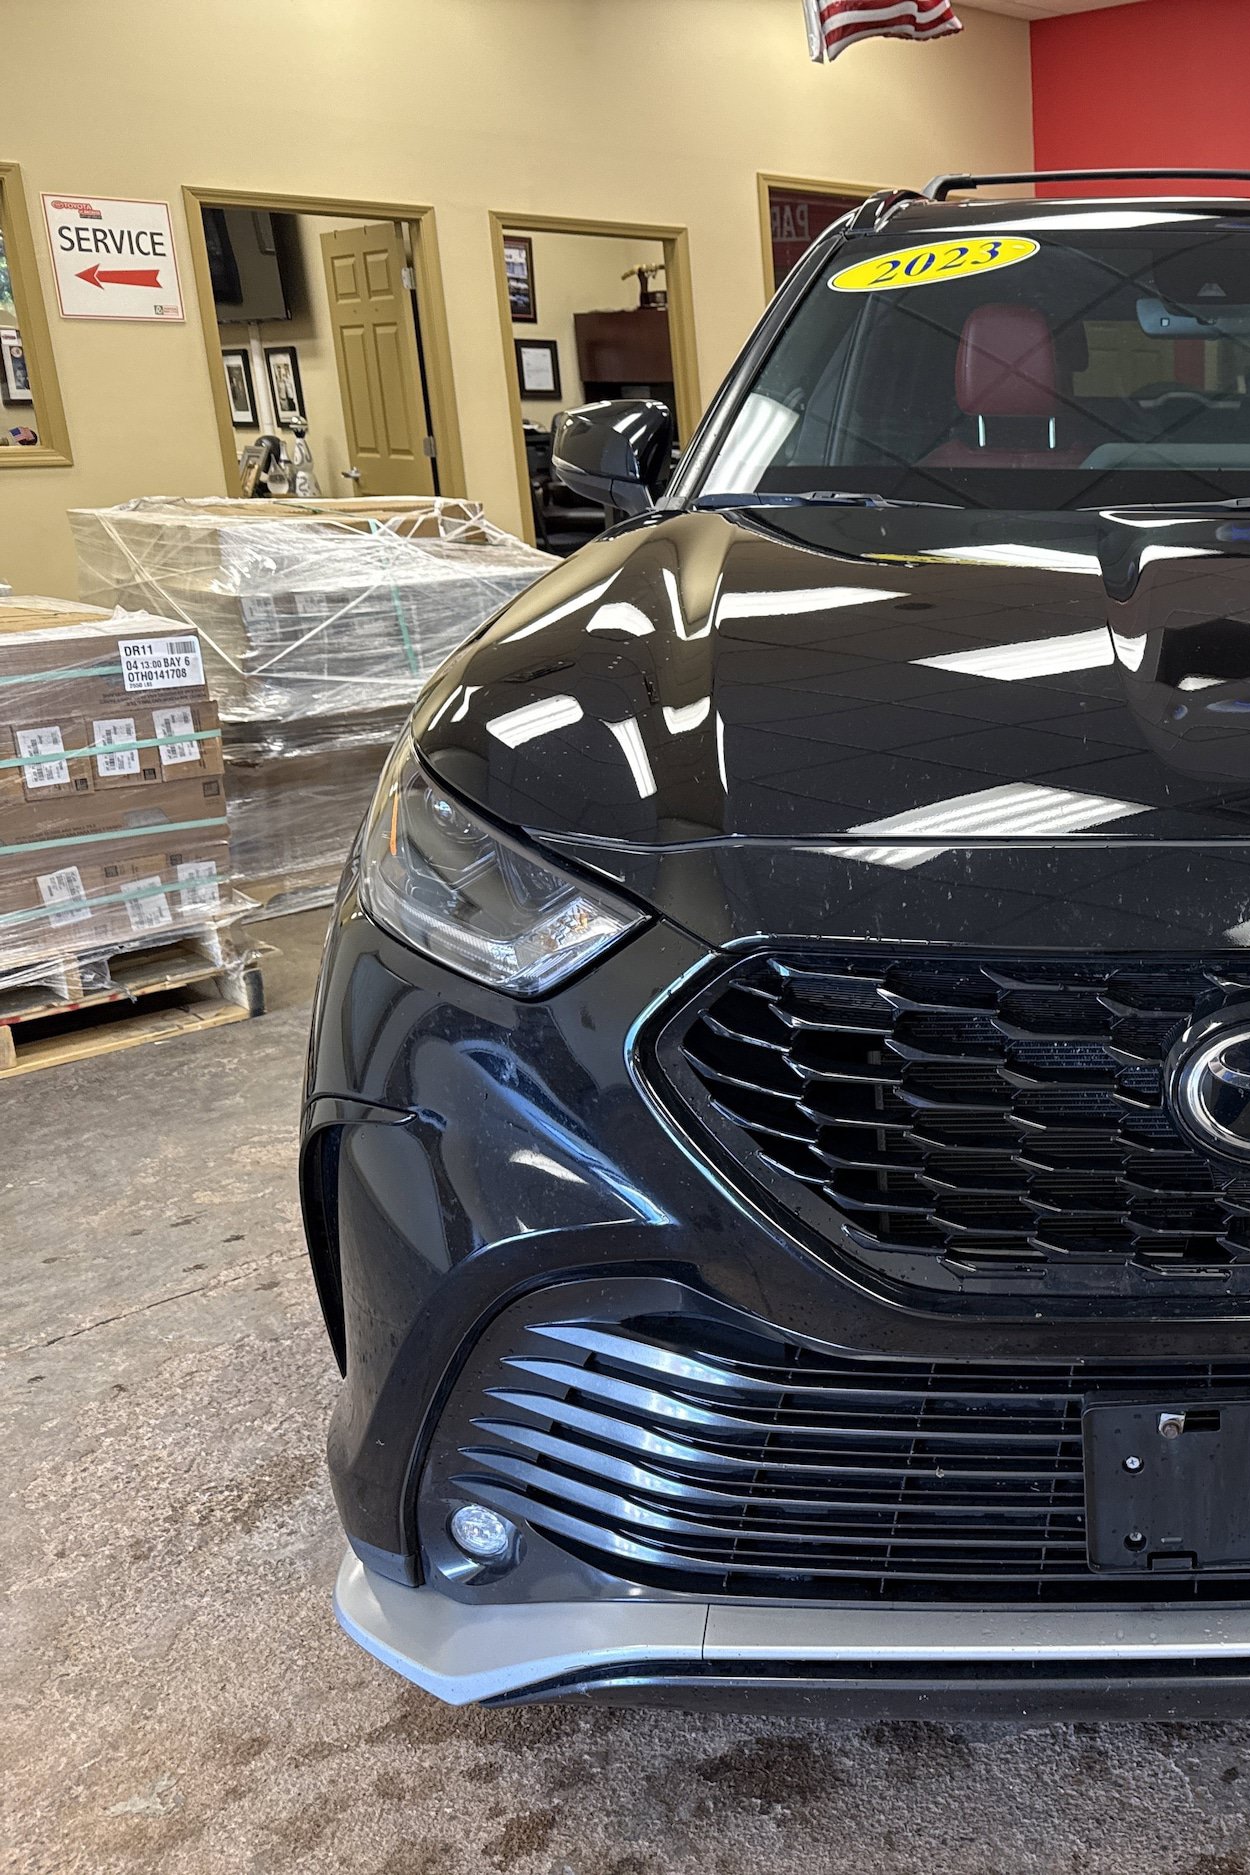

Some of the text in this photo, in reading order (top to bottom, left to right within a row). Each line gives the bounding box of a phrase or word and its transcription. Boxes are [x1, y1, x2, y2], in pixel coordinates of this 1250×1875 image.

[64, 202, 92, 210] TOYOTA
[57, 225, 167, 257] SERVICE
[868, 241, 1002, 285] 2023
[124, 644, 153, 657] DR11
[126, 656, 190, 671] 04 13:00 BAY 6
